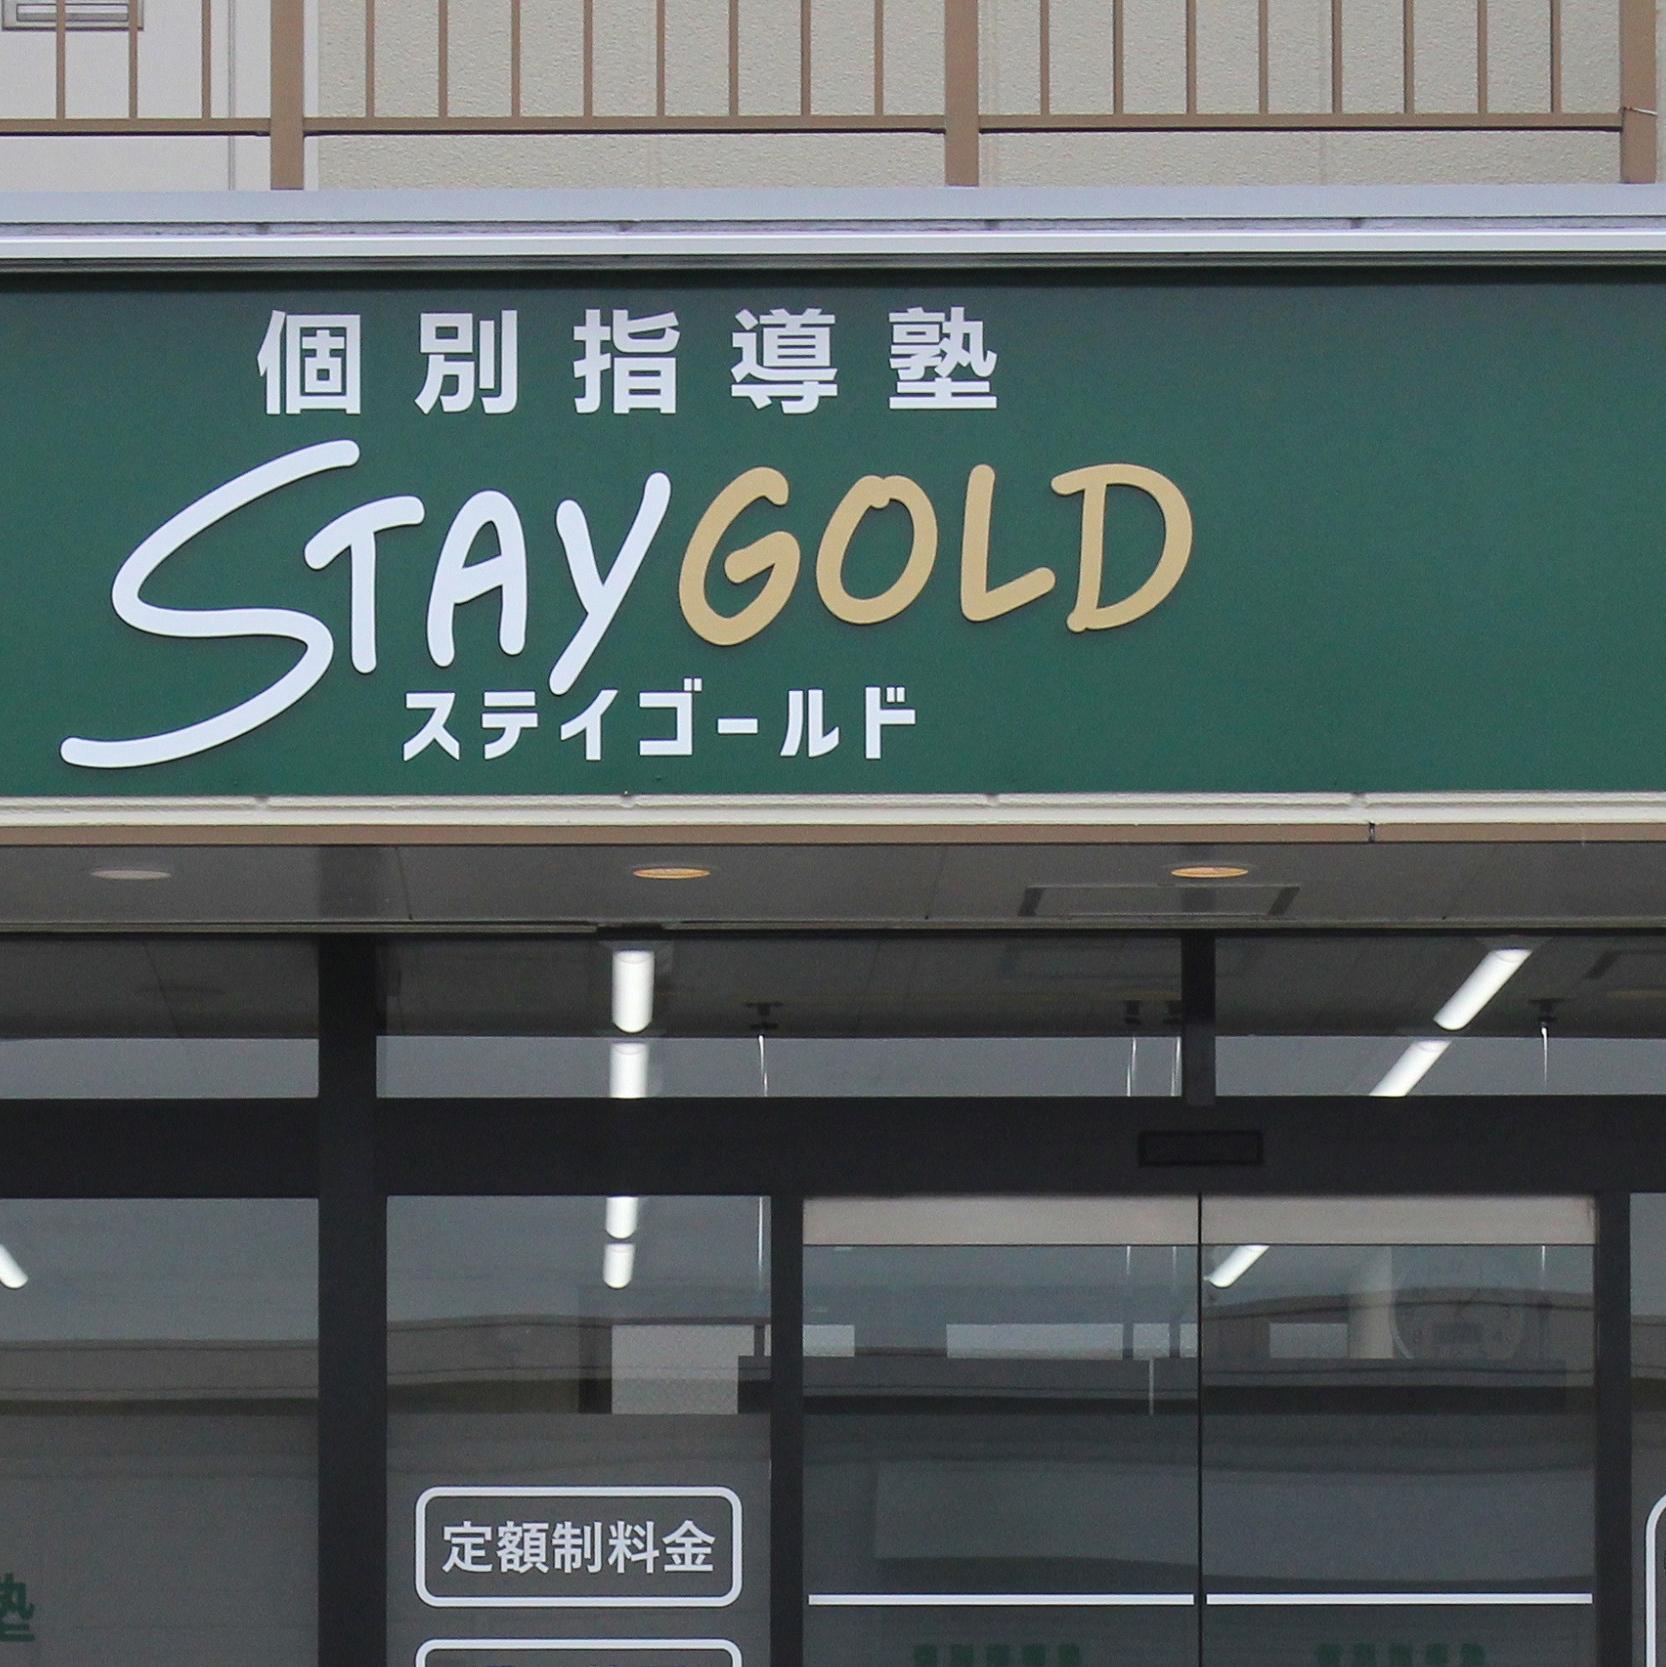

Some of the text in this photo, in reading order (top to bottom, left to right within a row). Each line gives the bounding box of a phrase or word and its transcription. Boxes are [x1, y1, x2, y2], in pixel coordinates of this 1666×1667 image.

[257, 306, 997, 414] 個別指導塾
[402, 678, 917, 762] ステイゴールド
[442, 1520, 716, 1574] 定額制料金
